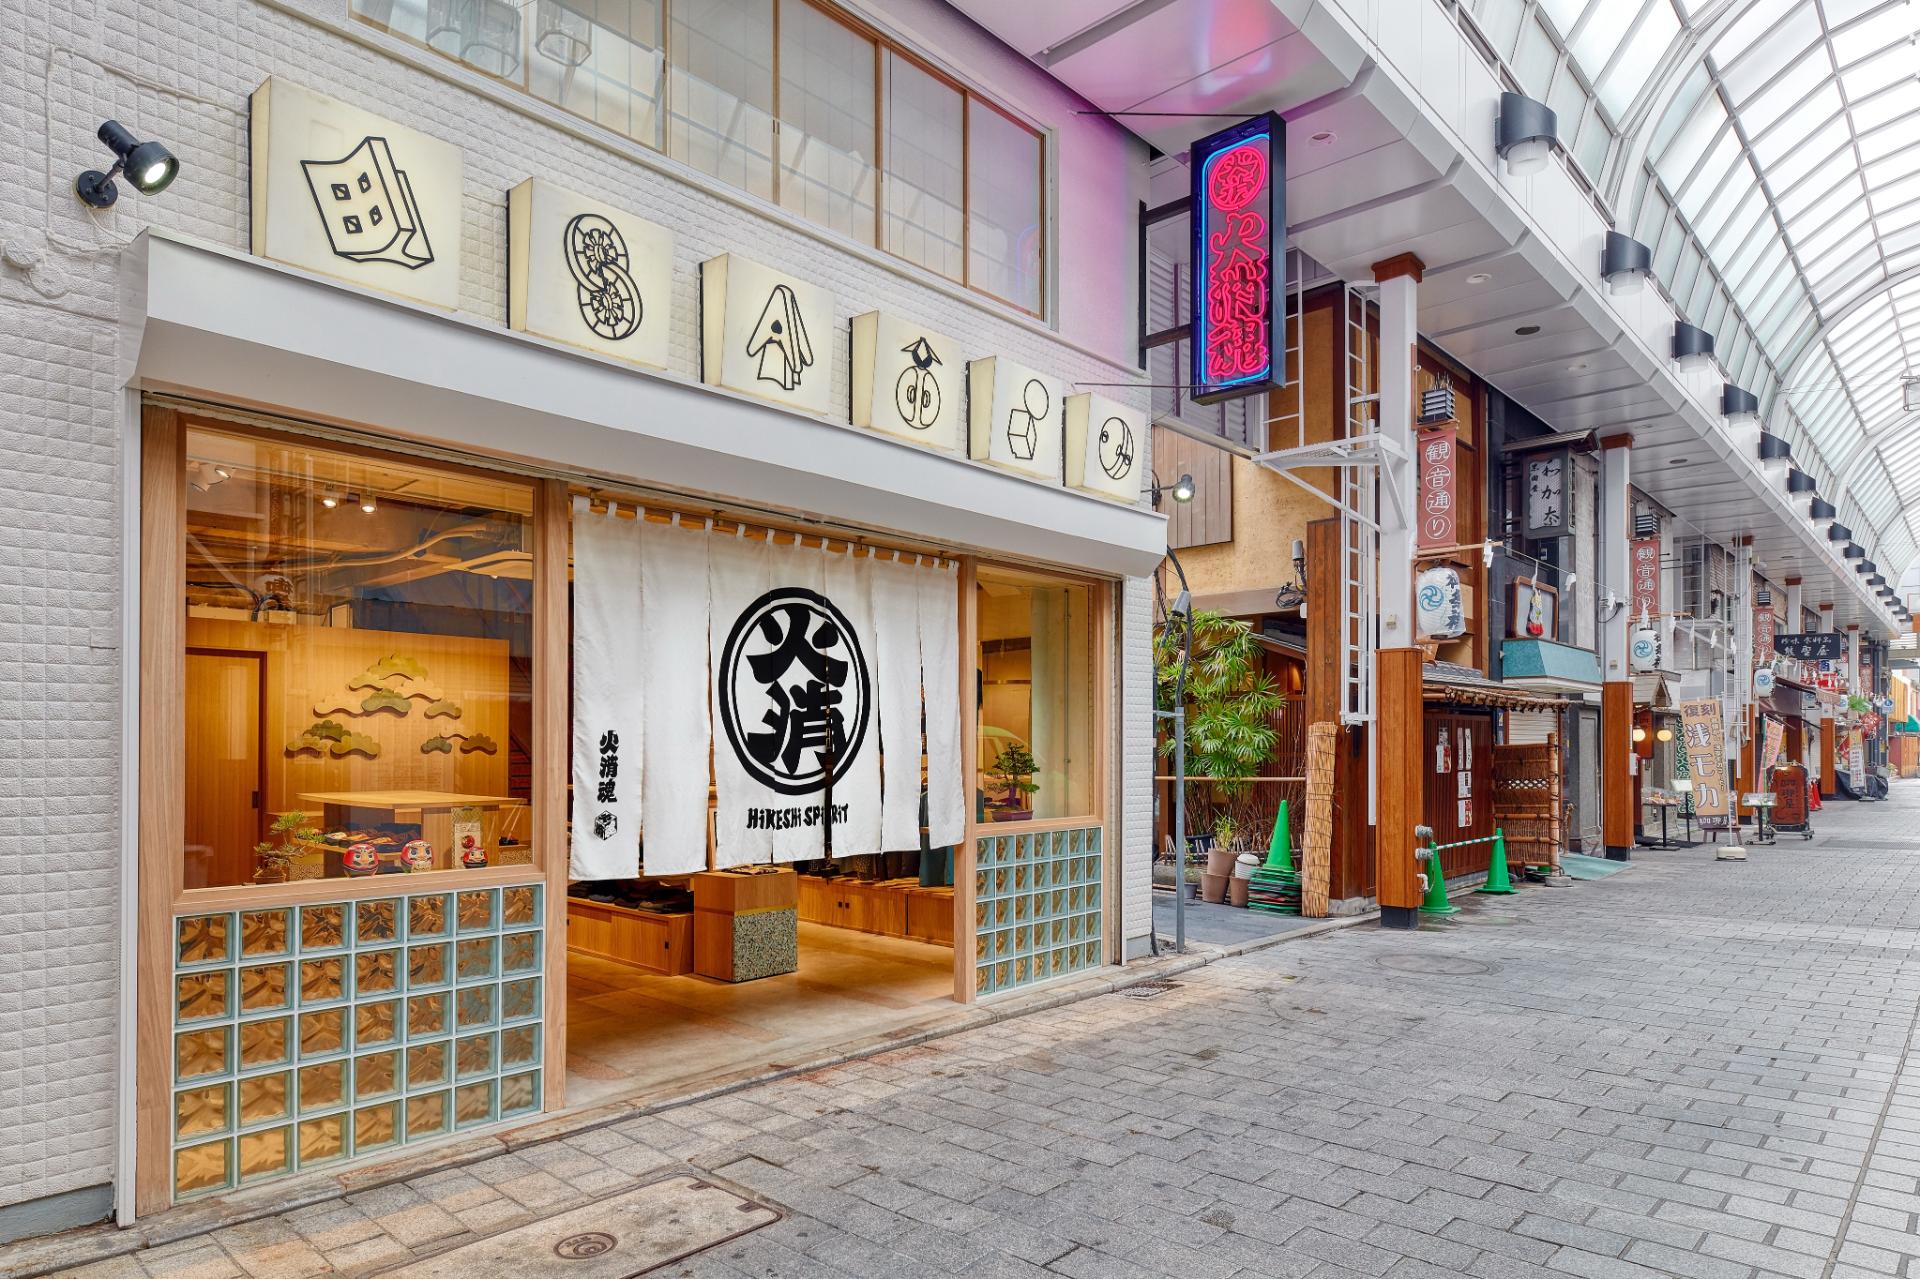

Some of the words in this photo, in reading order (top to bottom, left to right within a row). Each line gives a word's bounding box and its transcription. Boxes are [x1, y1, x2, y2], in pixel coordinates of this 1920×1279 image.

[1426, 441, 1450, 538] 観音通り
[1637, 547, 1655, 608] 観音通り
[746, 606, 849, 775] 火消
[1684, 703, 1716, 717] 復刻
[597, 730, 619, 803] 火消魂
[1685, 723, 1719, 808] 浅モカ
